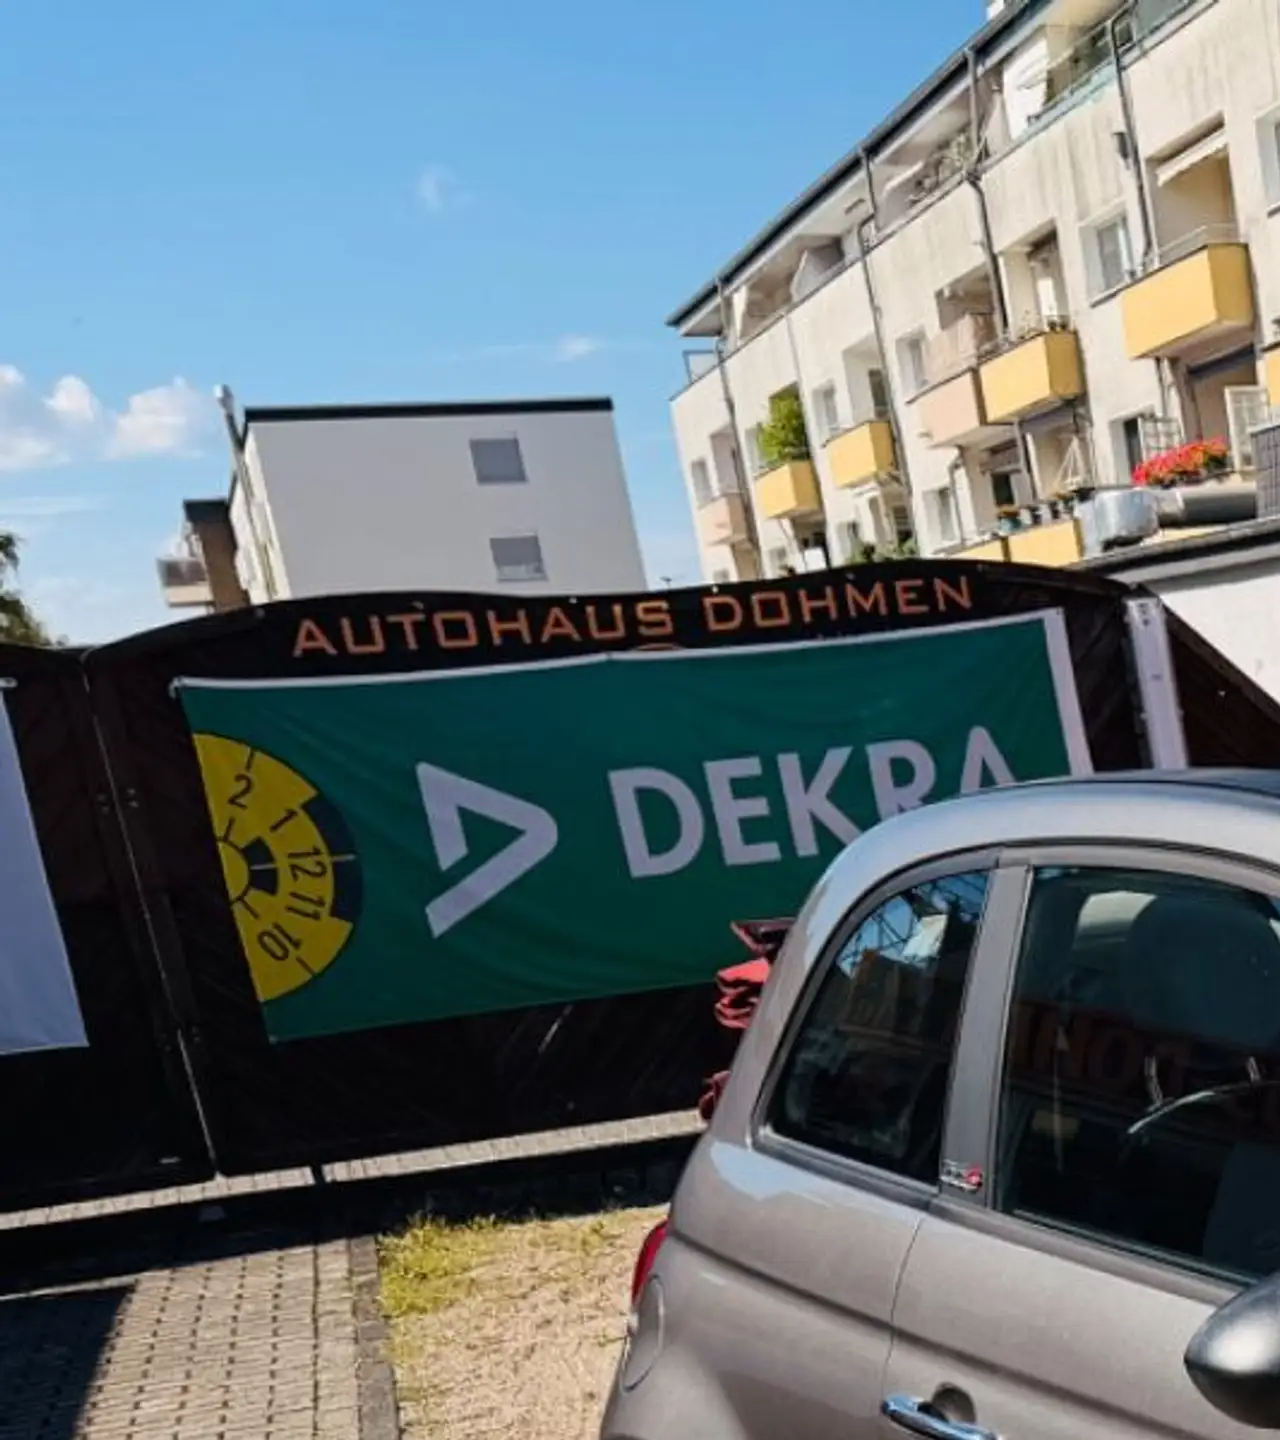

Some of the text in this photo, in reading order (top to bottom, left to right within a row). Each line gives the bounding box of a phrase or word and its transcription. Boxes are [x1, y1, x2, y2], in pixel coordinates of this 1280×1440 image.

[292, 575, 972, 657] AUTOHAUS DOHMEN
[228, 773, 252, 809] 2
[608, 725, 1015, 879] DEKRA
[269, 808, 298, 832] 1
[287, 846, 327, 881] 12
[285, 891, 325, 920] 11
[257, 922, 301, 961] 10
